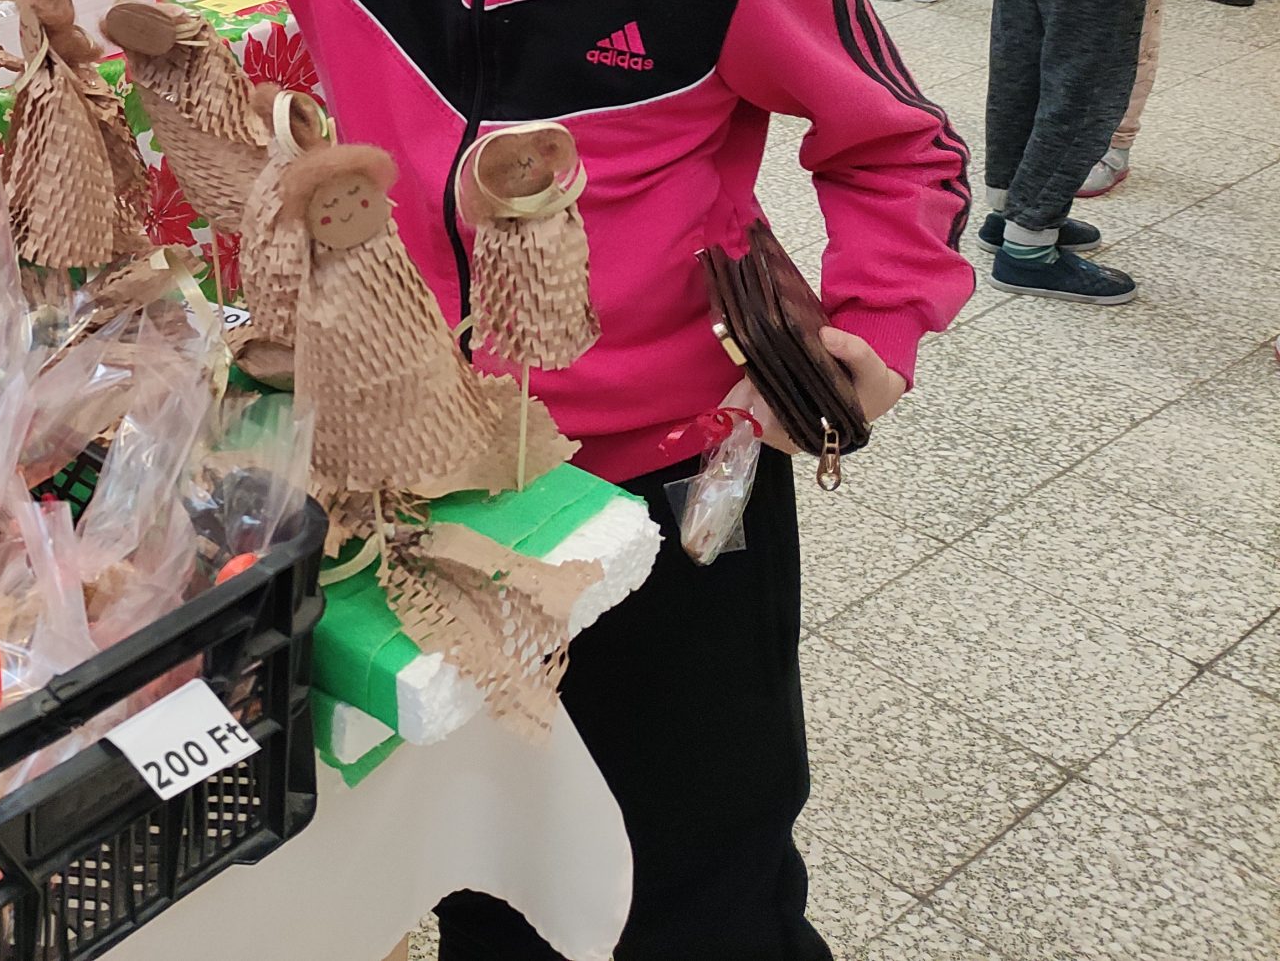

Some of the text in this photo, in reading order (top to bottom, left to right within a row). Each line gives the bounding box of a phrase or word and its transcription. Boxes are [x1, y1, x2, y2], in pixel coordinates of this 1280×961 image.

[586, 50, 654, 71] adidas
[142, 721, 249, 790] 200 Ft
